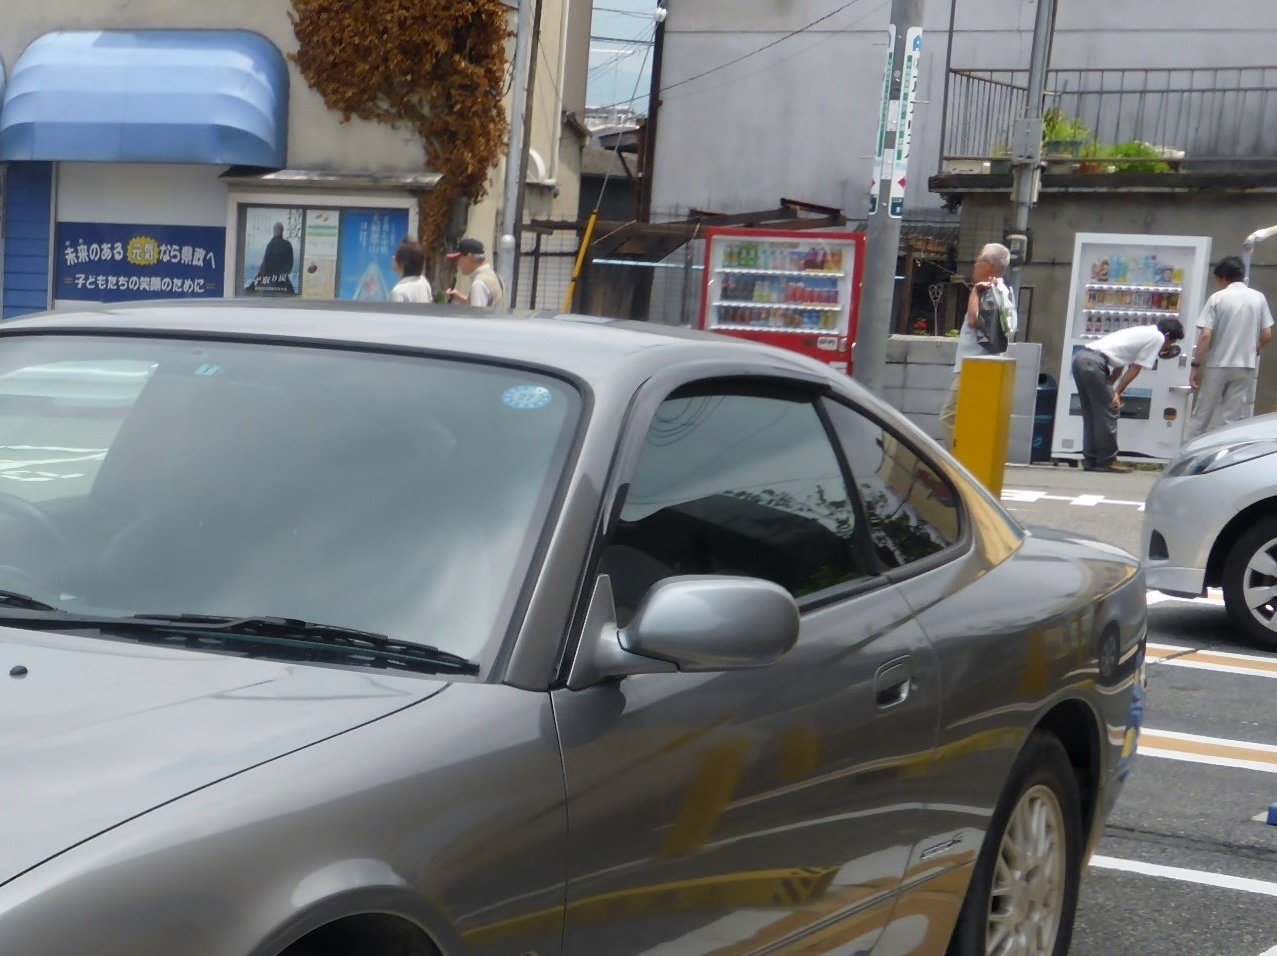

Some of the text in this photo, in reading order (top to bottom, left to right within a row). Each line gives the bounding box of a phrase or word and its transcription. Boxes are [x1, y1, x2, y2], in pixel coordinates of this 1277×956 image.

[75, 274, 205, 293] 子どもたちの笑顔のために
